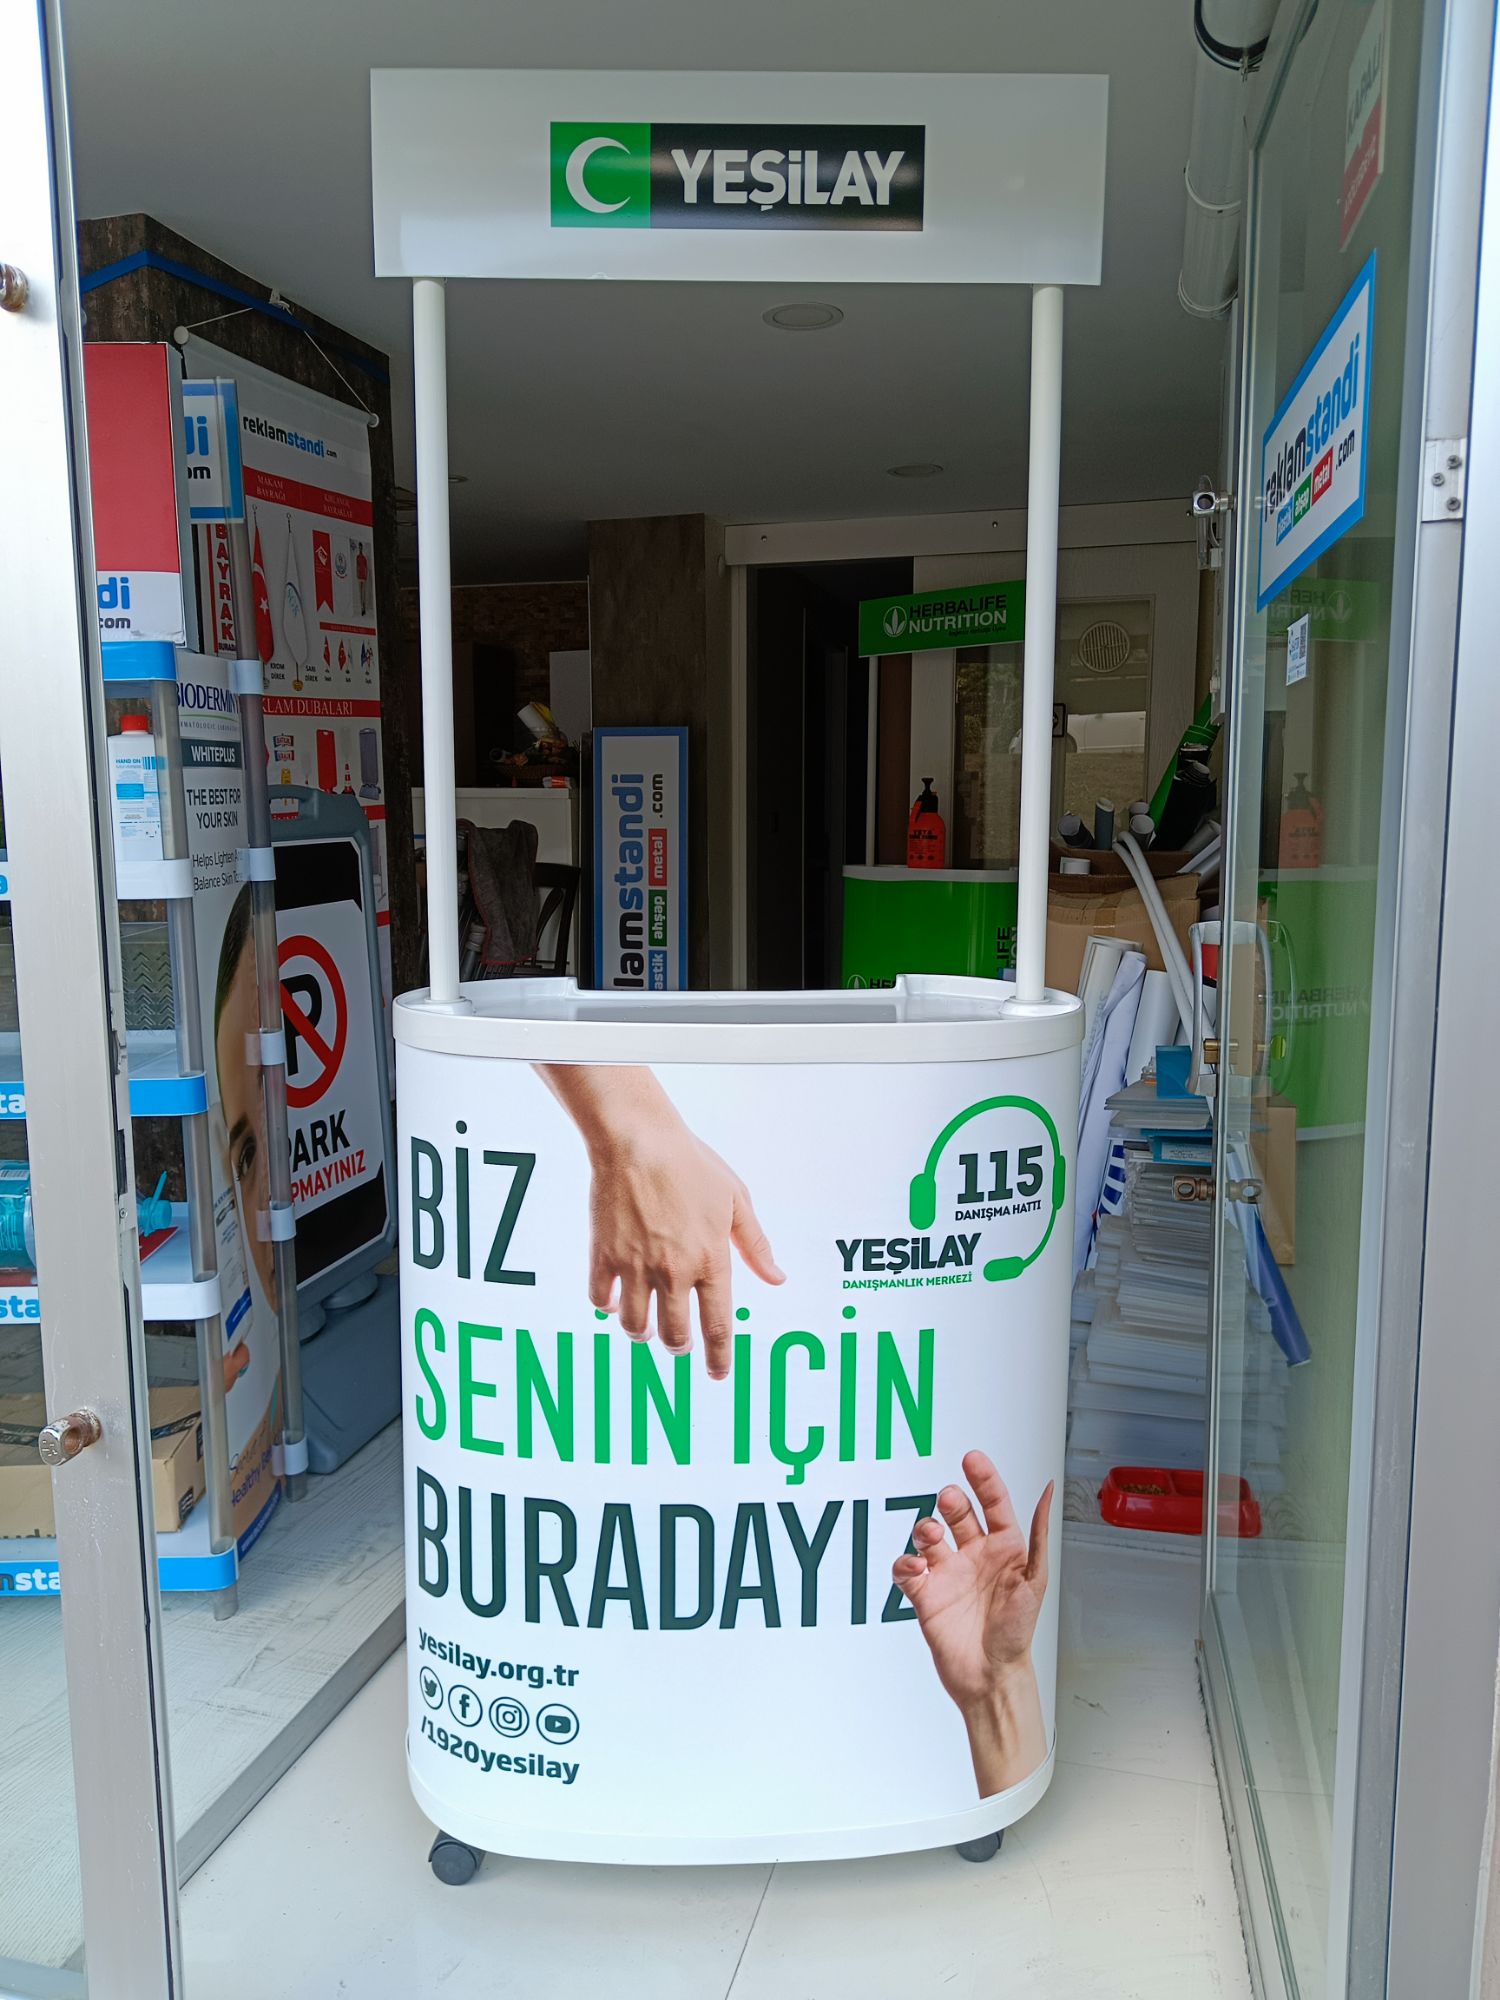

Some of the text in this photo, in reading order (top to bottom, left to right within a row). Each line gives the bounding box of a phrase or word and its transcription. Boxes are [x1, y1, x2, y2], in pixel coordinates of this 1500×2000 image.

[242, 416, 325, 458] reklamstandi
[1264, 331, 1360, 523] reklamstandi
[1313, 456, 1331, 494] metal
[909, 594, 1007, 620] HERBALIFE
[909, 610, 1007, 634] NUTRITION
[297, 699, 353, 715] DUBALARI
[191, 745, 236, 763] WHITEPLUS
[186, 788, 207, 806] THE
[208, 788, 228, 806] BEST
[652, 773, 664, 818] .com
[196, 811, 238, 829] YOUR SKIN
[192, 854, 214, 870] Helps
[651, 836, 663, 879] metal
[193, 874, 221, 892] Balance
[651, 895, 666, 940] ahşap
[956, 1145, 1044, 1205] 115
[410, 1120, 537, 1286] BİZ
[955, 1199, 1042, 1222] DANIŞMA HATTI
[842, 1271, 973, 1292] DANIŞMANLIK MERKEZİ
[414, 1305, 935, 1486] SENİN İÇİN
[416, 1466, 938, 1631] BURADAYIZ
[418, 1626, 580, 1690] yesilay.org.tr
[421, 1715, 580, 1785] /1920yesilay
